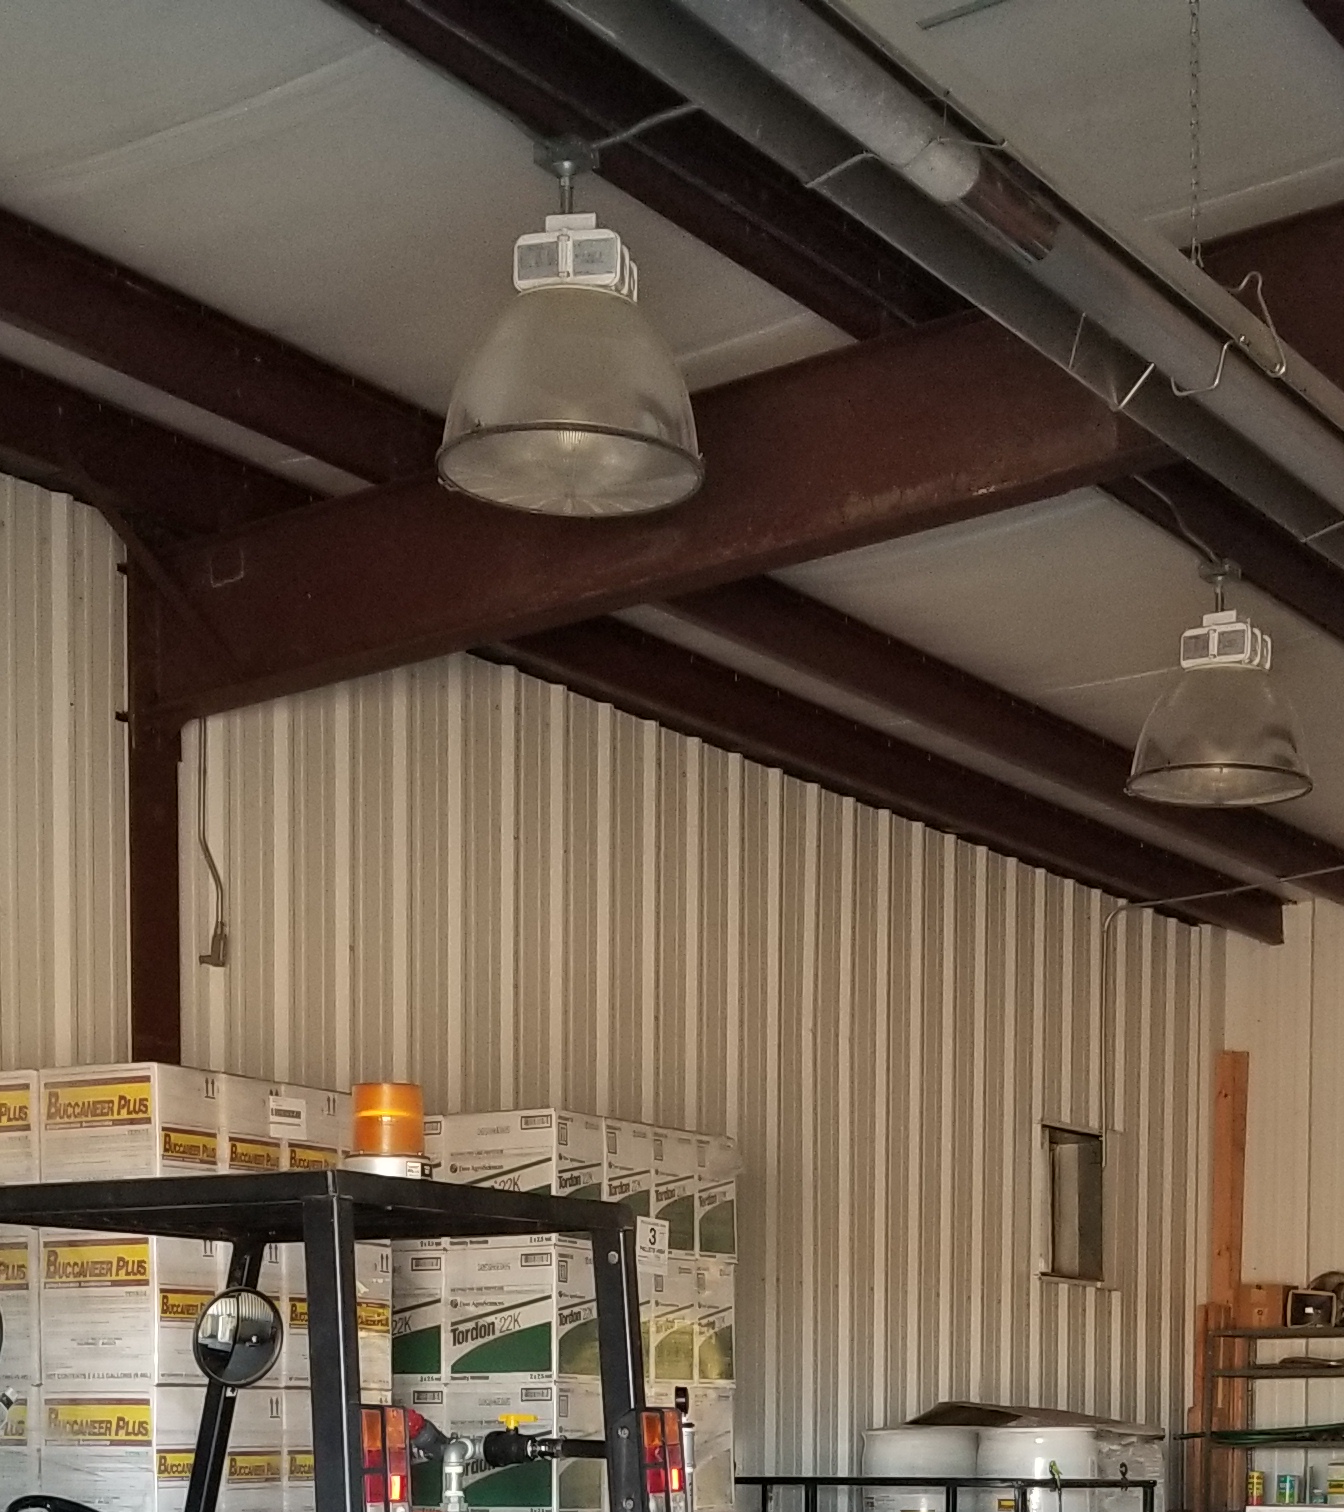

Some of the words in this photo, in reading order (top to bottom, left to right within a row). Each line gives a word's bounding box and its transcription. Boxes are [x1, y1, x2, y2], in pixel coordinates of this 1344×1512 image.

[46, 1090, 114, 1121] BUCCANEER
[117, 1094, 149, 1116] PLUS
[163, 1132, 201, 1154] BUCCANEER
[558, 1174, 581, 1189] Tordon
[608, 1181, 630, 1196] Tordon
[649, 1227, 656, 1245] 3
[46, 1251, 113, 1281] BUCCANEER
[115, 1256, 147, 1277] PLUS
[450, 1321, 496, 1346] Tordon
[499, 1312, 521, 1334] 22K
[559, 1310, 581, 1326] Tordon
[48, 1407, 113, 1438] BUCCANEER
[115, 1416, 150, 1436] PLUS
